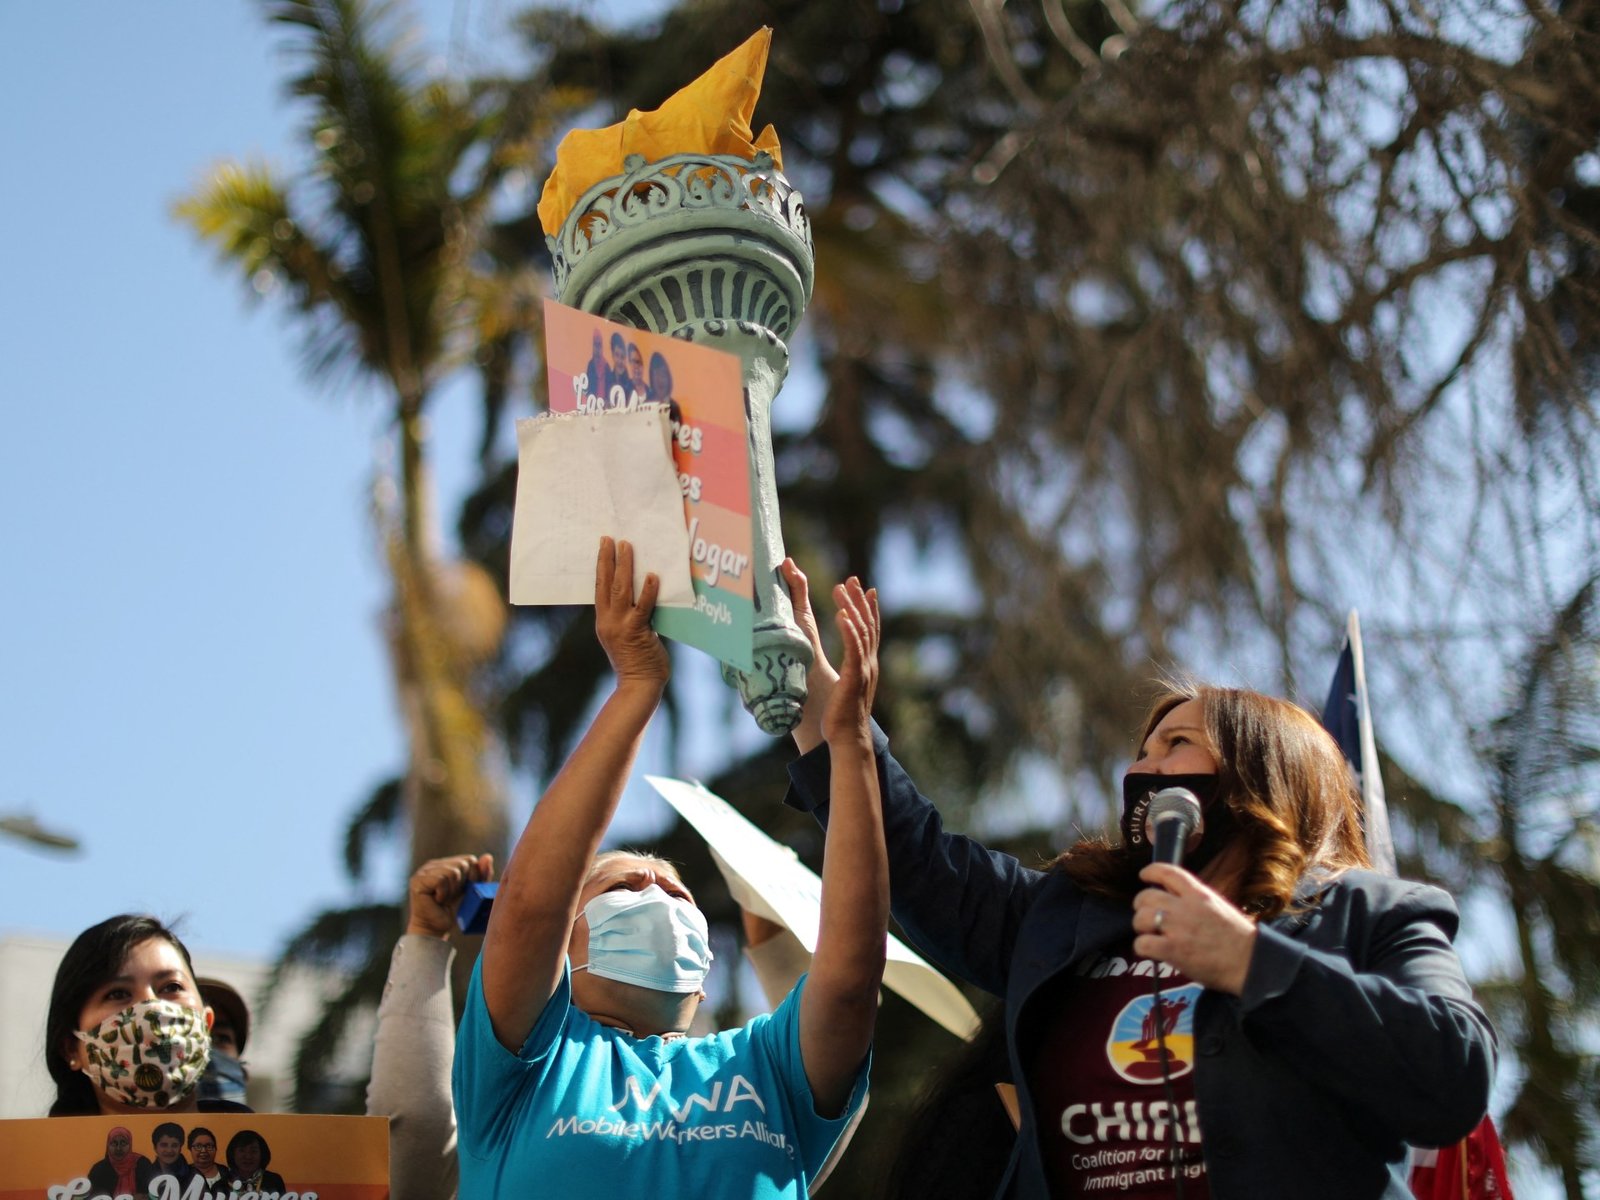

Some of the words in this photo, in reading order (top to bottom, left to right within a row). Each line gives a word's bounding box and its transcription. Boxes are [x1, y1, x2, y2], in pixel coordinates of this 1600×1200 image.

[1130, 790, 1158, 844] CHIRLA
[546, 1116, 639, 1140] Mobile
[1072, 1149, 1136, 1171] Coalition
[1140, 1146, 1164, 1161] for
[1084, 1166, 1165, 1191] Immigrant
